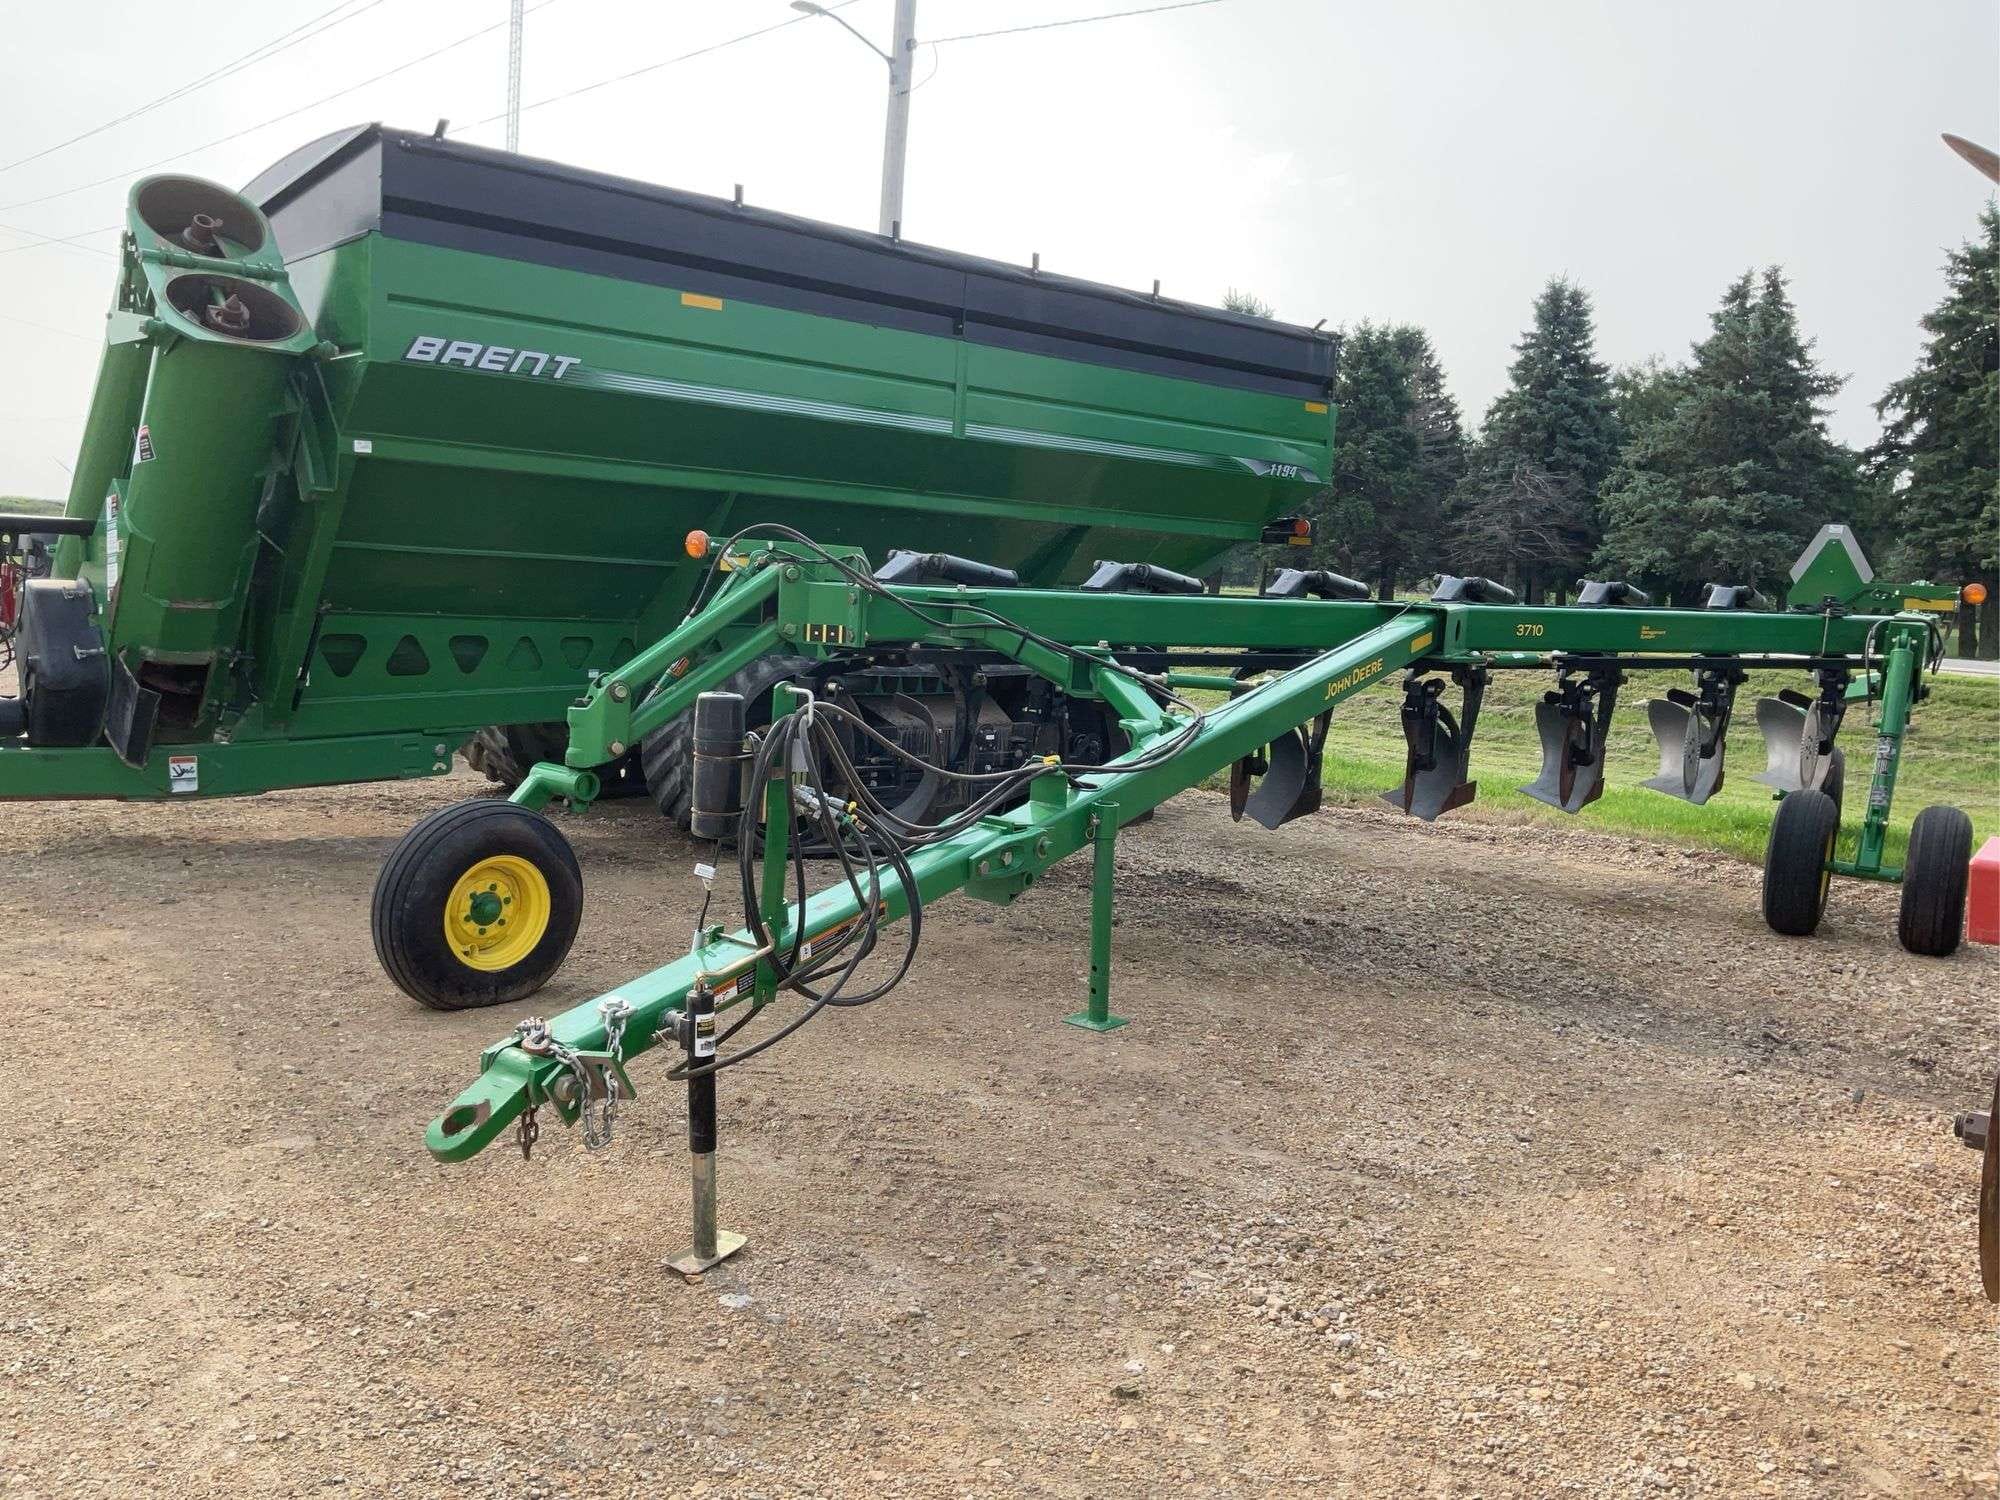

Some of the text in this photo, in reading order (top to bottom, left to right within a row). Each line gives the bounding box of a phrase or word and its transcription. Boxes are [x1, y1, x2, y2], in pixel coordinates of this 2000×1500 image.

[404, 336, 581, 379] BRENT
[1270, 463, 1298, 478] 1194
[1516, 623, 1544, 637] 3710
[1324, 658, 1383, 700] JOHN DEERE
